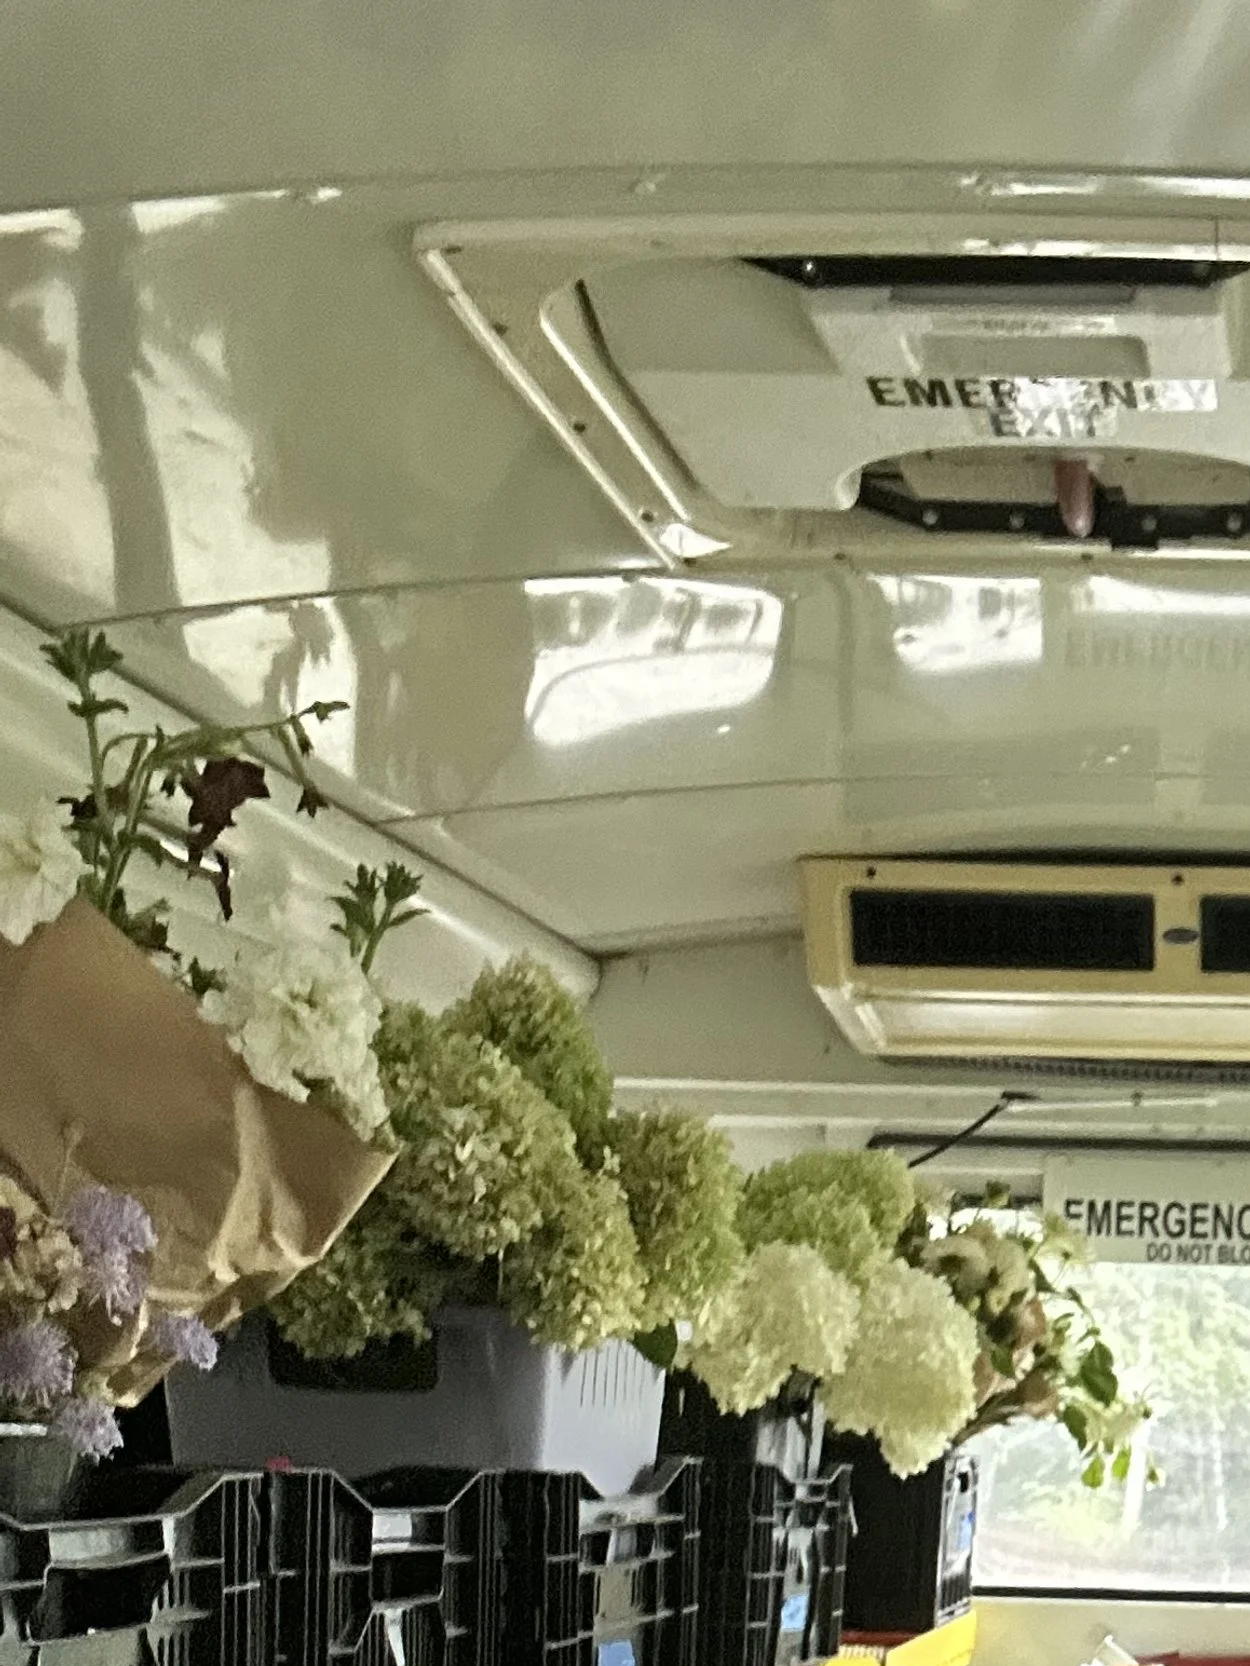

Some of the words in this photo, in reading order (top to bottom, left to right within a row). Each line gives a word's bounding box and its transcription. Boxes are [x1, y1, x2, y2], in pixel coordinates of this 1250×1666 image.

[865, 376, 1211, 410] EMERENCY
[989, 405, 1103, 438] EXIT
[1146, 1243, 1172, 1263] DO
[1176, 1243, 1213, 1264] NOT
